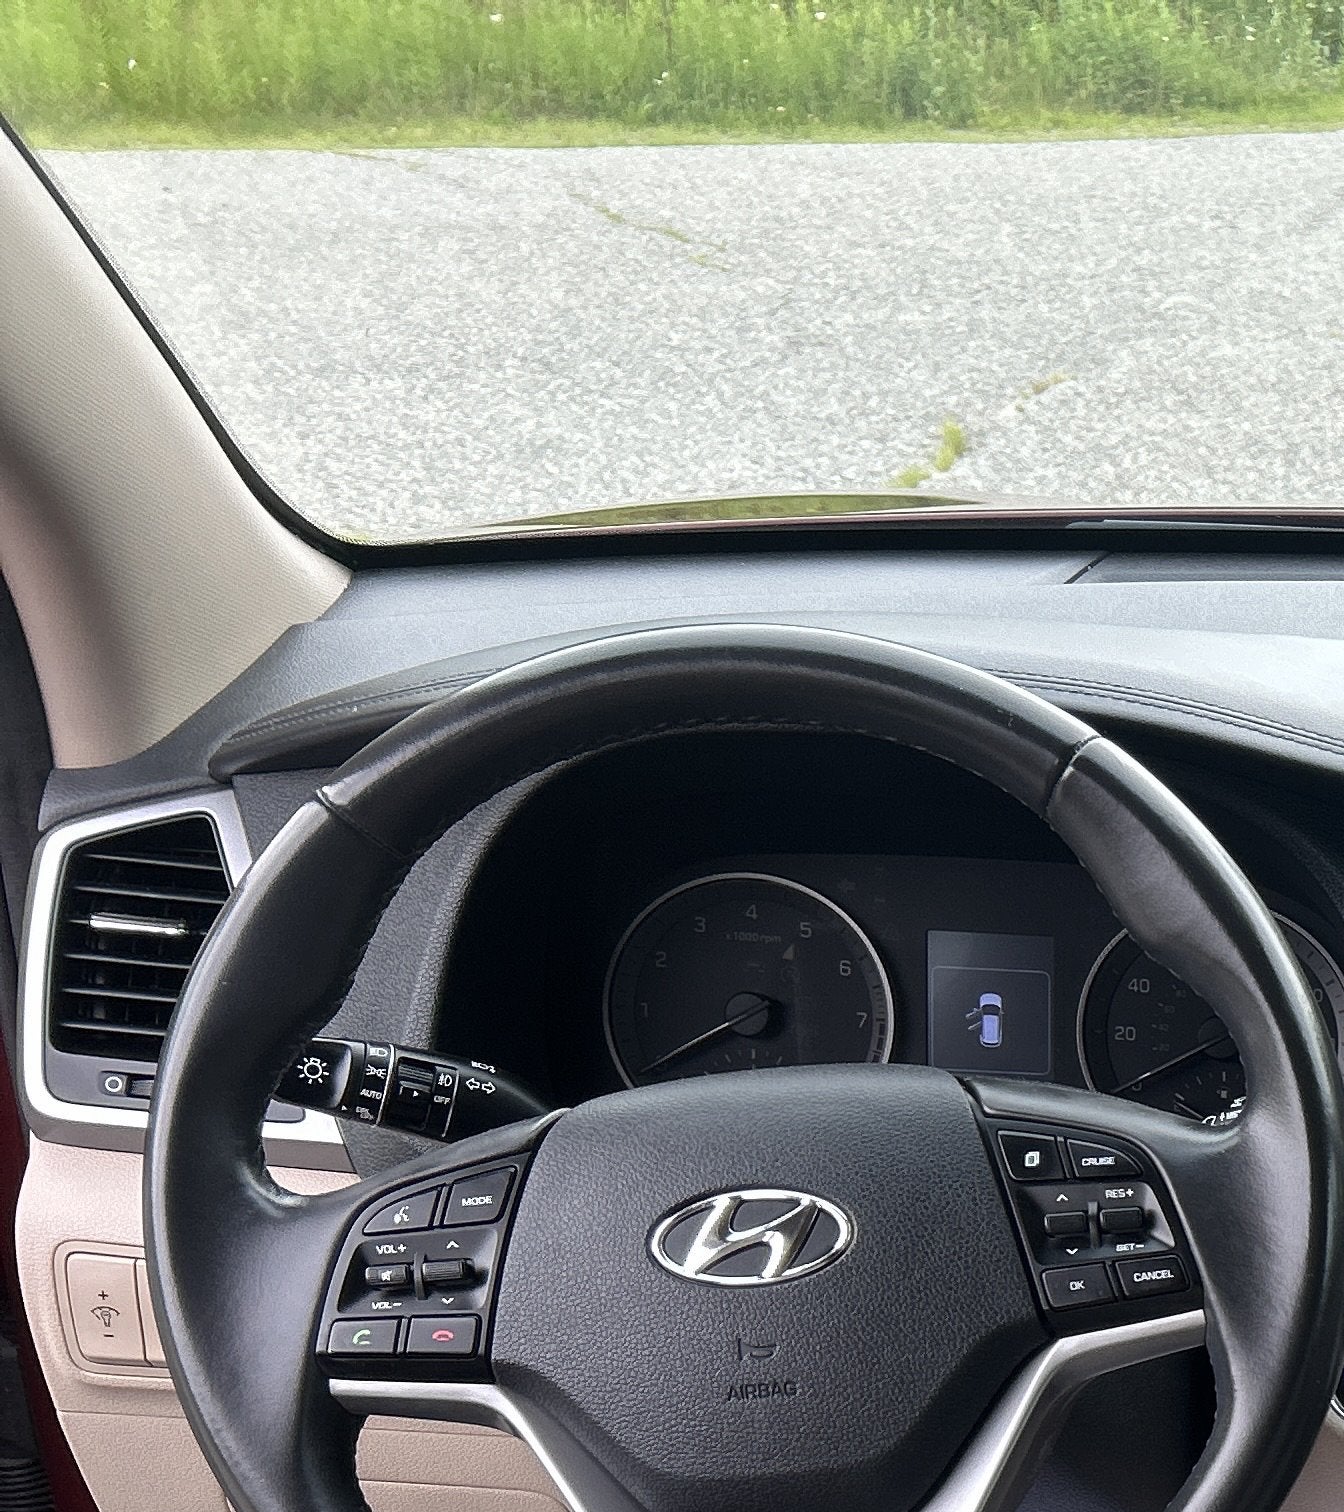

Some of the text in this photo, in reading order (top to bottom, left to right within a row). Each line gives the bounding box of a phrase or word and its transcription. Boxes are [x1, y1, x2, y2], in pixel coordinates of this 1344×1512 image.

[745, 904, 758, 920] 4
[693, 917, 706, 933] 3
[800, 922, 812, 939] 5
[655, 952, 667, 968] 2
[839, 960, 851, 977] 6
[1128, 978, 1151, 993] 40
[856, 1011, 868, 1028] 7
[1114, 1026, 1136, 1041] 20
[360, 1088, 382, 1100] AUTO
[1081, 1156, 1115, 1166] CRUISE
[461, 1195, 493, 1206] MODE
[1133, 1269, 1174, 1282] CANCEL
[1069, 1280, 1085, 1291] OK
[728, 1380, 798, 1402] AIRBAG
